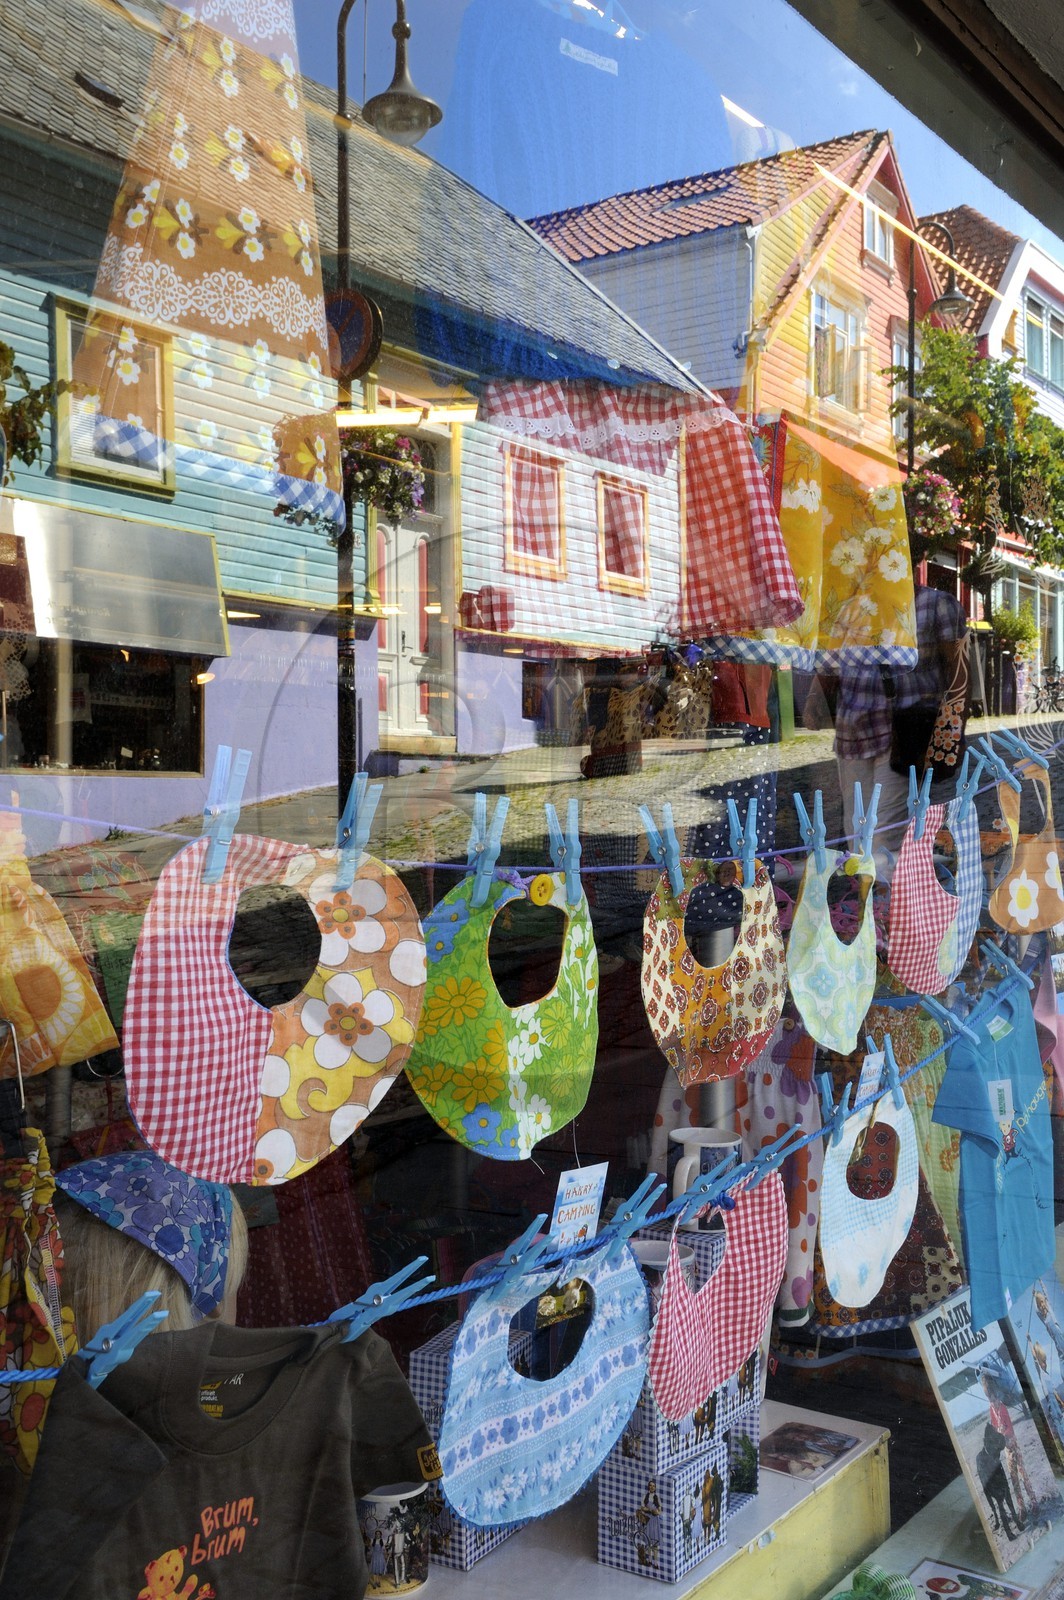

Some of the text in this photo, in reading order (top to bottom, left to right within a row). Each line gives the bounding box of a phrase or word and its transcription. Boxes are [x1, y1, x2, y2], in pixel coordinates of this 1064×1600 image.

[557, 1201, 596, 1224] CAMPING
[925, 1300, 971, 1346] PIPALUK
[934, 1327, 988, 1370] GONZALES
[200, 1496, 259, 1539] Brum,
[605, 1514, 640, 1538] WIZAR
[191, 1526, 246, 1566] brum
